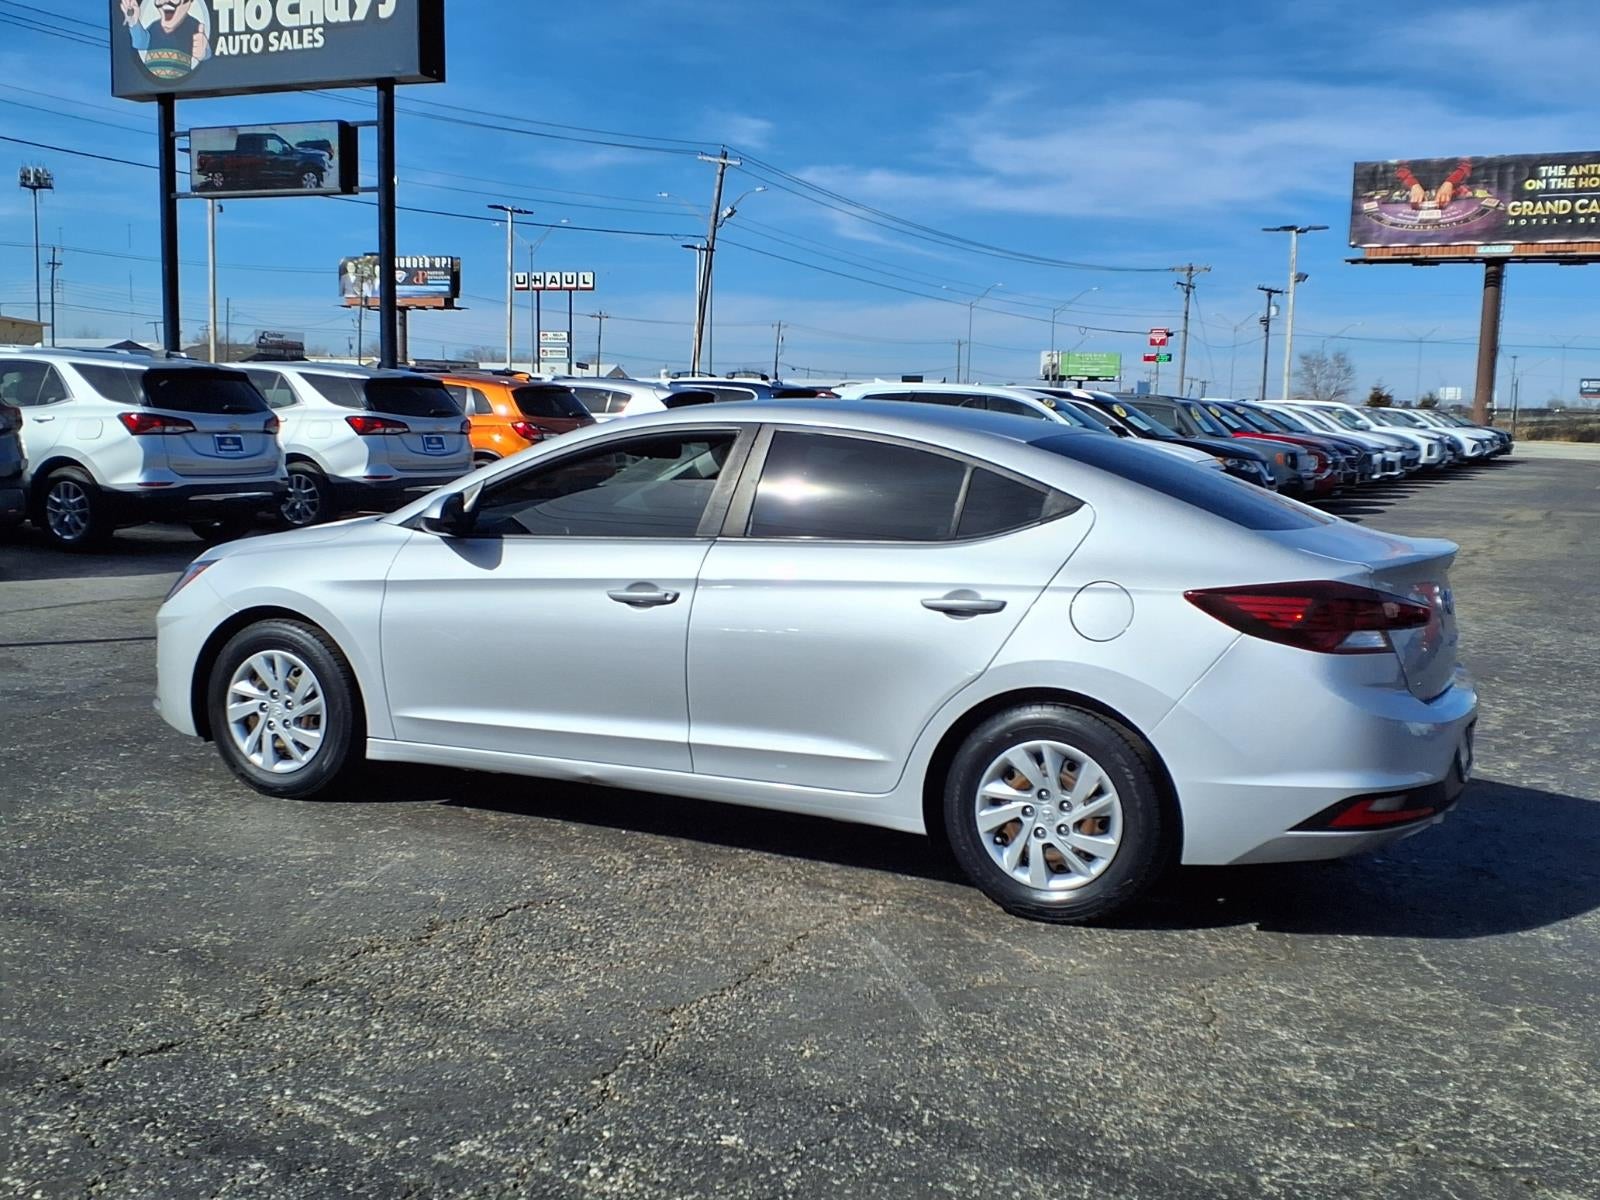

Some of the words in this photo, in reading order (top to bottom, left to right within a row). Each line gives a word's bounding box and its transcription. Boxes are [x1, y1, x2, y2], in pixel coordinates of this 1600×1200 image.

[215, 33, 264, 56] AUTO
[268, 27, 325, 52] SALES
[1540, 165, 1566, 177] THE
[1525, 178, 1546, 190] ON
[1549, 177, 1575, 189] THE
[1507, 199, 1572, 216] GRAND
[1508, 218, 1558, 226] HOTEL
[435, 256, 451, 268] UP!
